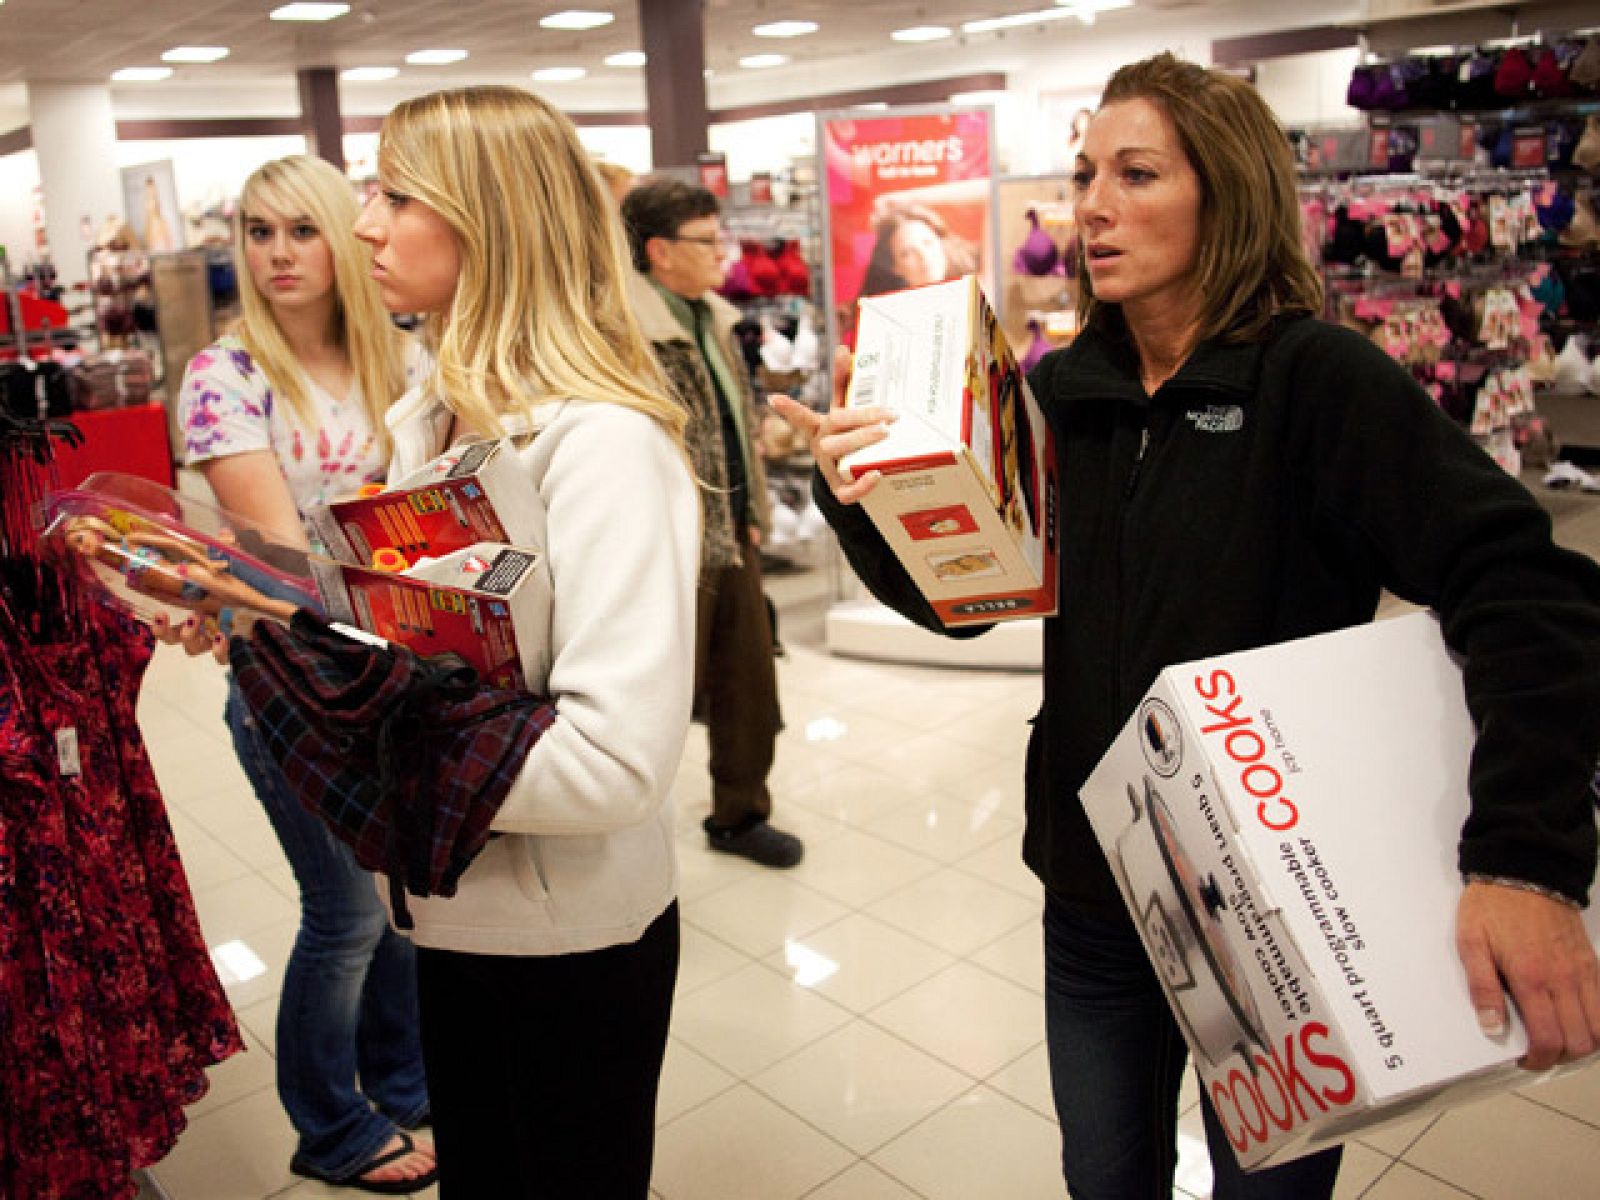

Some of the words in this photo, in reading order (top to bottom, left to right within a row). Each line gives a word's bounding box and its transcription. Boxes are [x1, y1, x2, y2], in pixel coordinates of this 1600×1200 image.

[1195, 669, 1299, 831] cooks
[1191, 774, 1203, 790] 5
[1222, 854, 1311, 1013] programmable
[1298, 837, 1339, 901] cooker
[1279, 841, 1365, 986] programmable
[1332, 906, 1366, 951] slow
[1255, 946, 1298, 1021] cooker
[1353, 989, 1394, 1048] quart
[1212, 1020, 1356, 1153] cooks
[1384, 1053, 1404, 1071] 5
